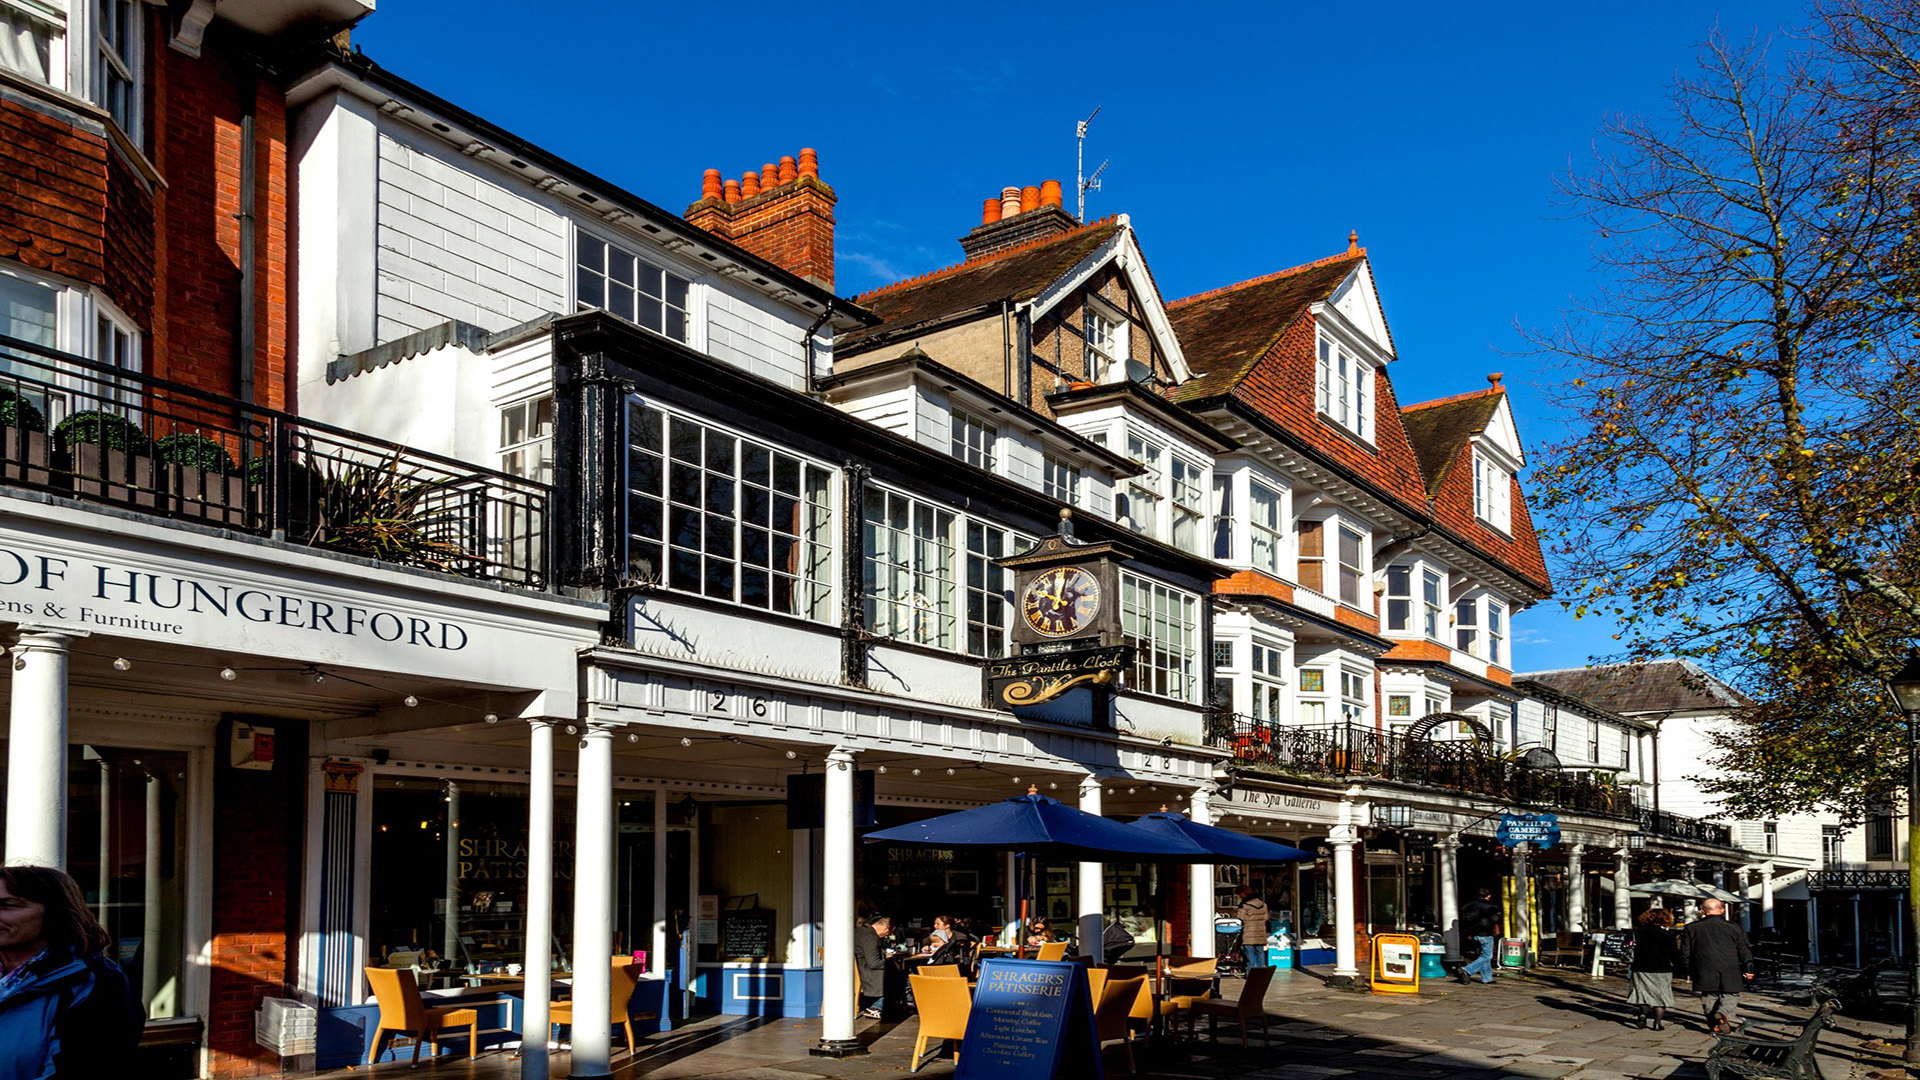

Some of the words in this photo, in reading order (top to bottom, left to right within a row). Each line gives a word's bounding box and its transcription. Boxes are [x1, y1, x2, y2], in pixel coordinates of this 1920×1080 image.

[0, 549, 68, 591] OF
[92, 564, 468, 651] HUNGERFORD
[43, 602, 67, 619] &
[79, 607, 183, 635] Furniture
[991, 665, 1017, 677] The
[1022, 658, 1077, 675] Pantiles
[1082, 653, 1121, 669] Clock
[1243, 790, 1260, 804] The
[1263, 789, 1280, 808] Spa
[1284, 792, 1321, 810] Galleries
[1509, 833, 1548, 841] CENTRE
[992, 970, 1064, 985] SHRAGER'S
[1021, 1009, 1053, 1019] Breakfasts
[992, 1016, 1020, 1025] Morning
[1021, 1018, 1042, 1026] Coffee
[1011, 1026, 1036, 1034] Lunches
[979, 1032, 1010, 1041] Afternoon
[1011, 1035, 1033, 1043] Cream
[1013, 1050, 1036, 1059] Gallery
